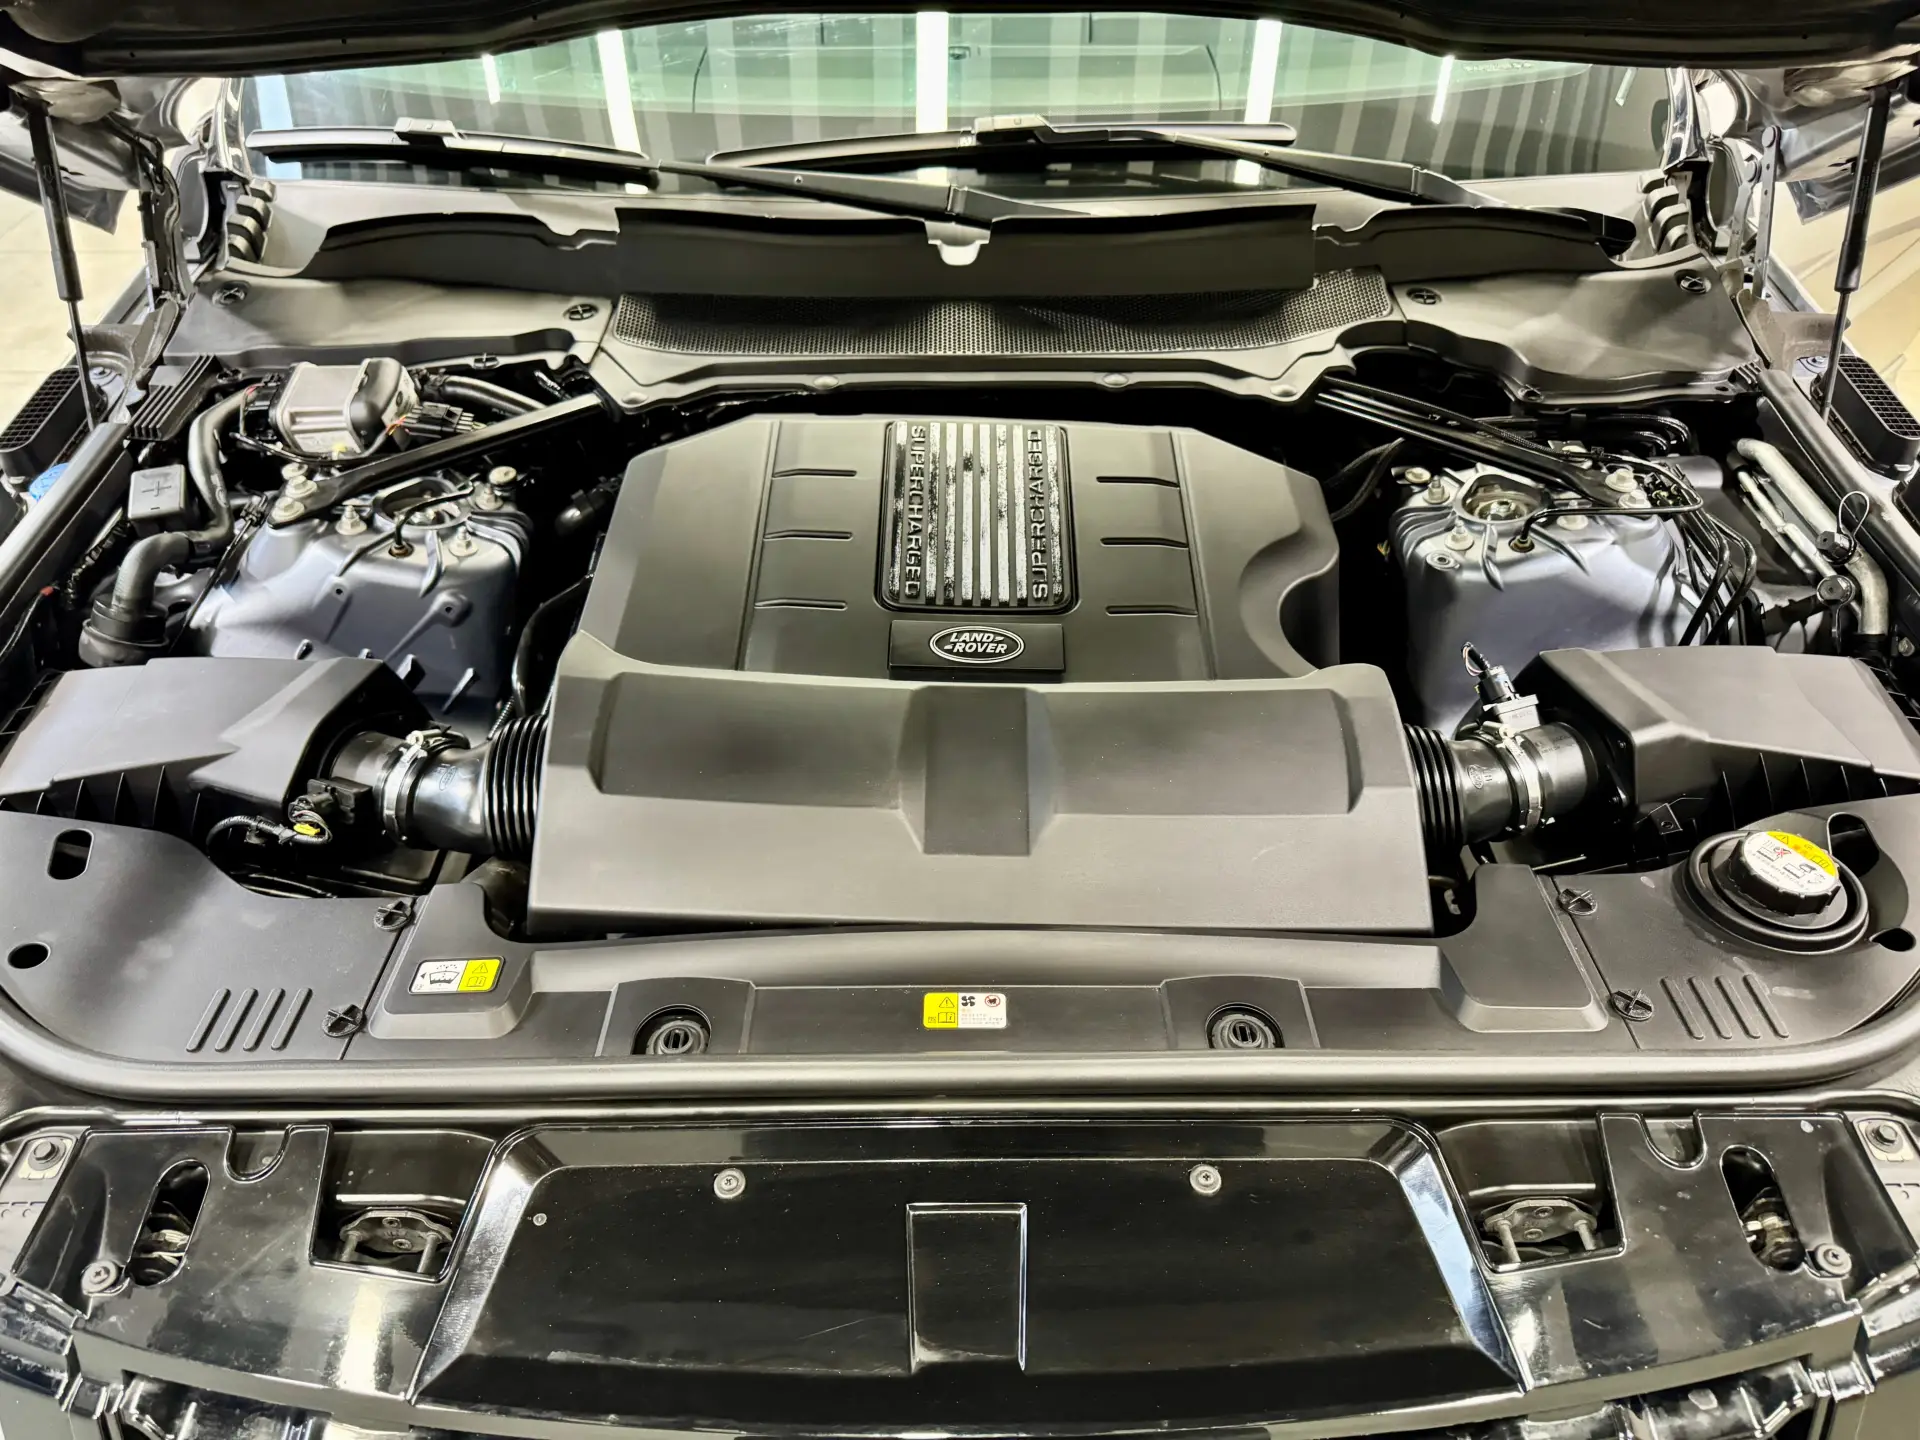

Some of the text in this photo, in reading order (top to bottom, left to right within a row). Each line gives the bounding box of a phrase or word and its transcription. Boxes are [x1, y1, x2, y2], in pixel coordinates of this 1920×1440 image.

[905, 425, 926, 597] SUPERCHARGED
[1027, 429, 1048, 600] SUPERCHARGED
[949, 632, 995, 642] LAND
[952, 642, 1008, 654] ROVER
